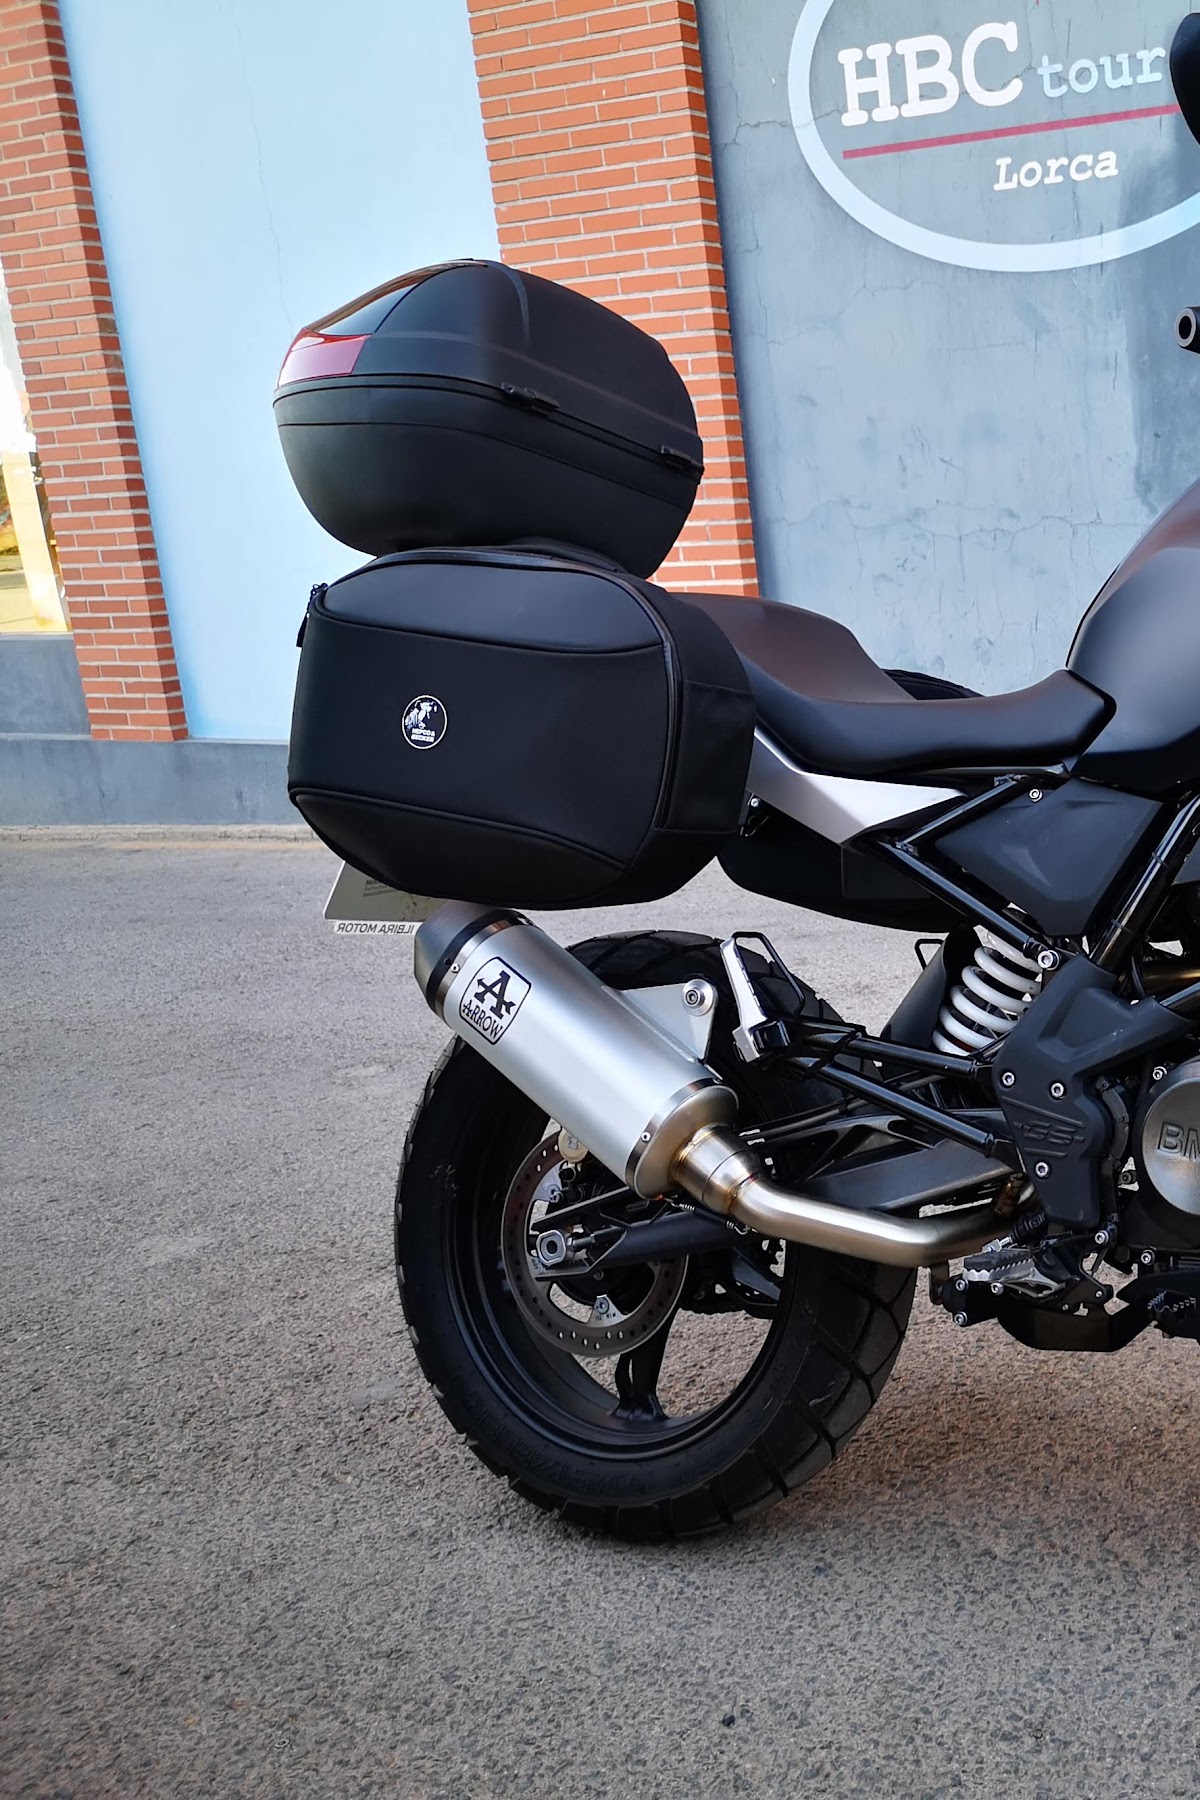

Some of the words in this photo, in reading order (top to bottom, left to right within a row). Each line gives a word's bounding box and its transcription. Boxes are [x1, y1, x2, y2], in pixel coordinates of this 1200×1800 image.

[837, 21, 1024, 127] HBC
[1037, 46, 1167, 99] tour
[993, 150, 1119, 193] Lorca
[462, 999, 503, 1040] ARROW
